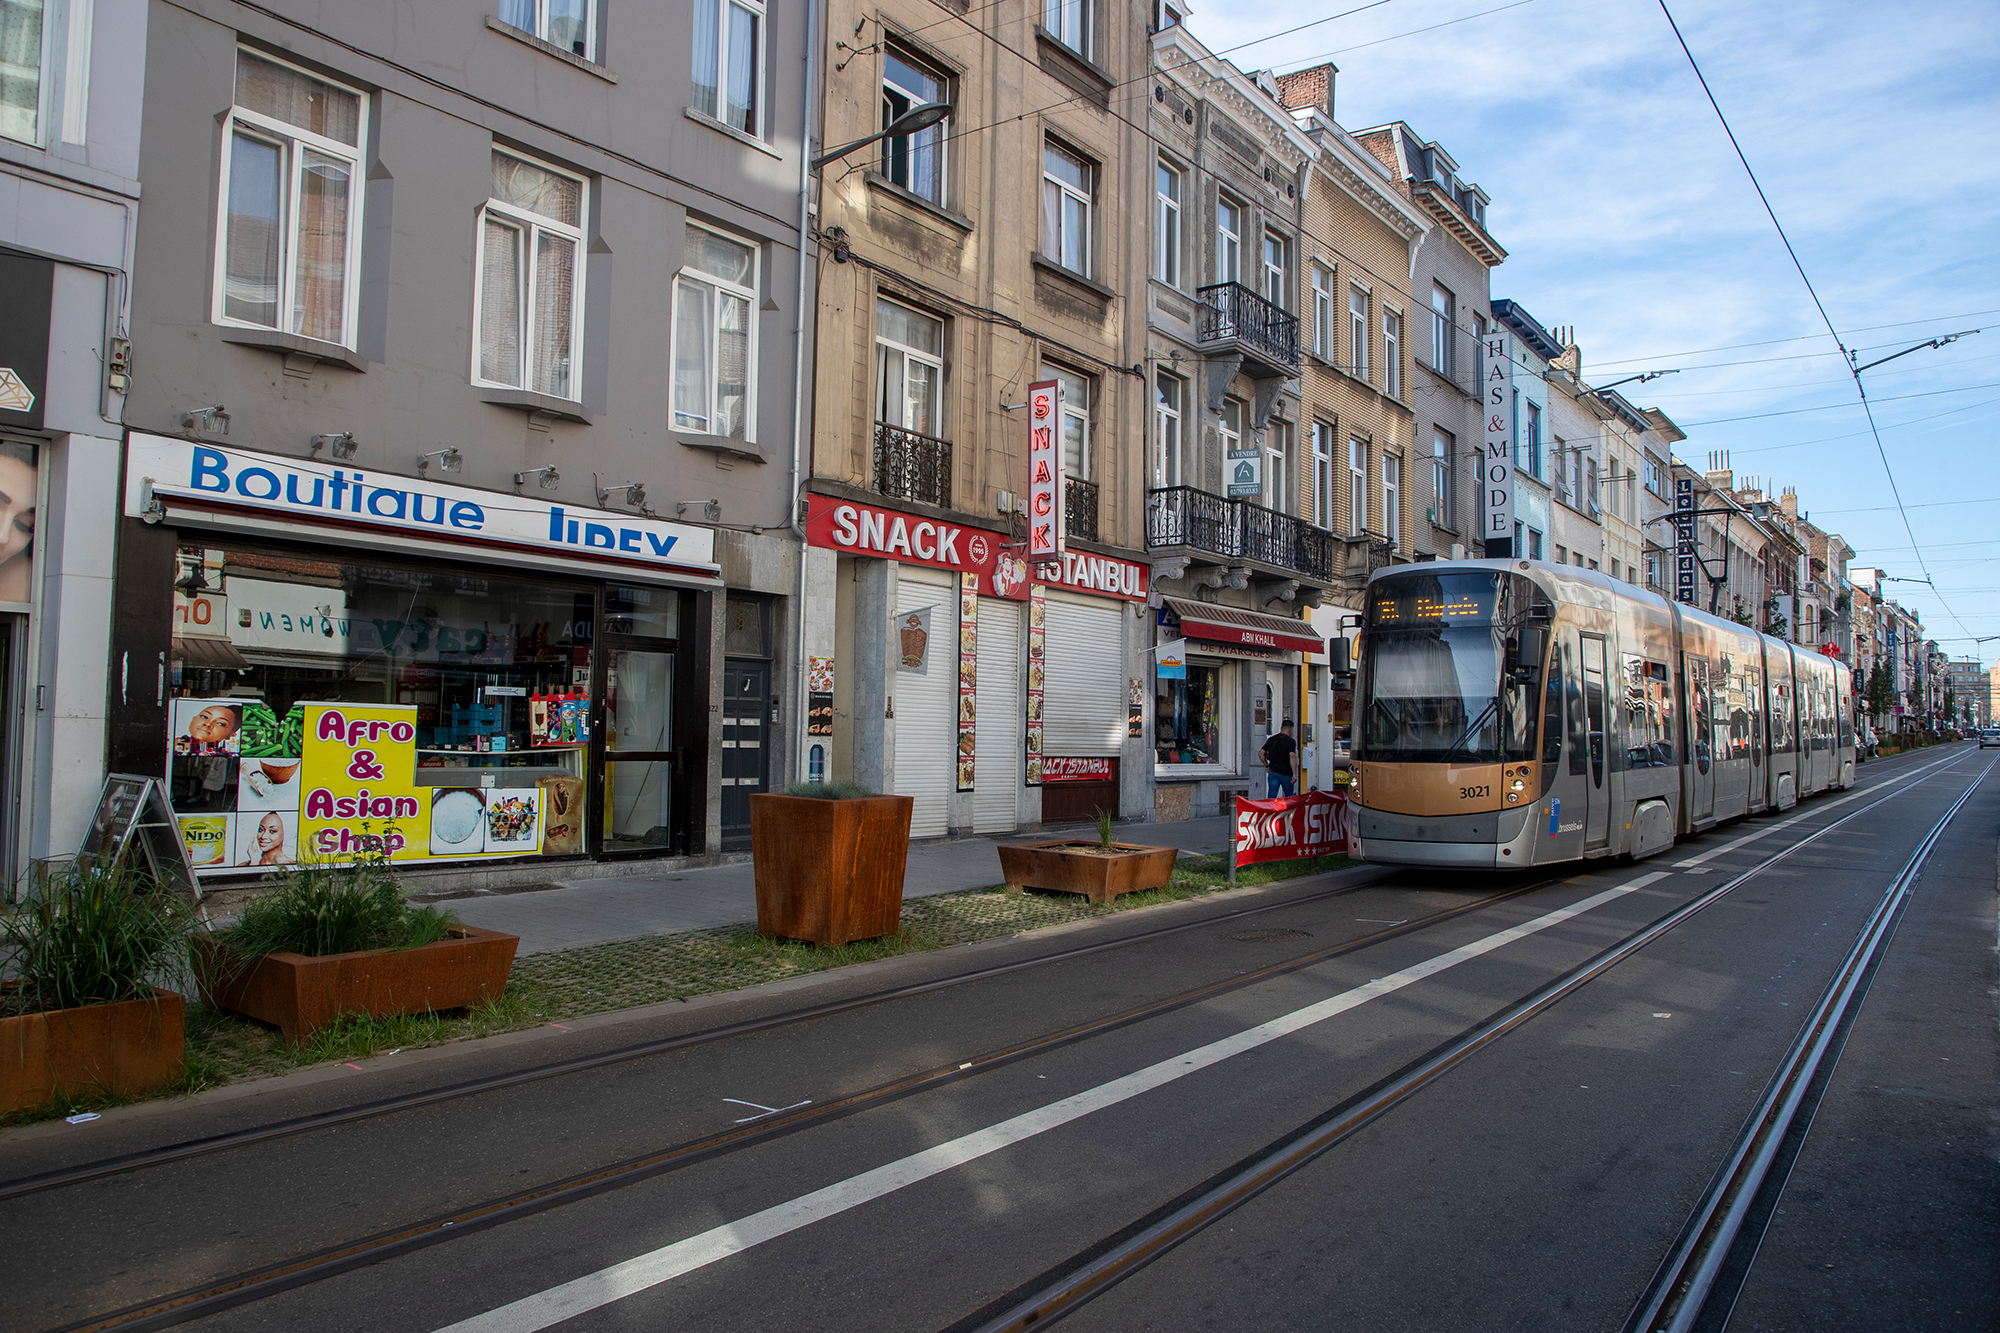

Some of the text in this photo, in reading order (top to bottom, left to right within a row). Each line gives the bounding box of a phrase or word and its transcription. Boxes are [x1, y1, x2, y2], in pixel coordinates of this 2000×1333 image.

[1031, 392, 1052, 550] SNACK
[1487, 440, 1509, 532] MODE
[832, 505, 961, 566] SNACK
[1200, 643, 1271, 659] DE MARQUES
[319, 711, 414, 747] Afro
[349, 752, 383, 779] &
[307, 790, 417, 820] Asian
[1459, 785, 1490, 799] 3021
[185, 830, 224, 841] NIDO
[318, 829, 404, 854] Shop
[1237, 807, 1297, 853] SNACK
